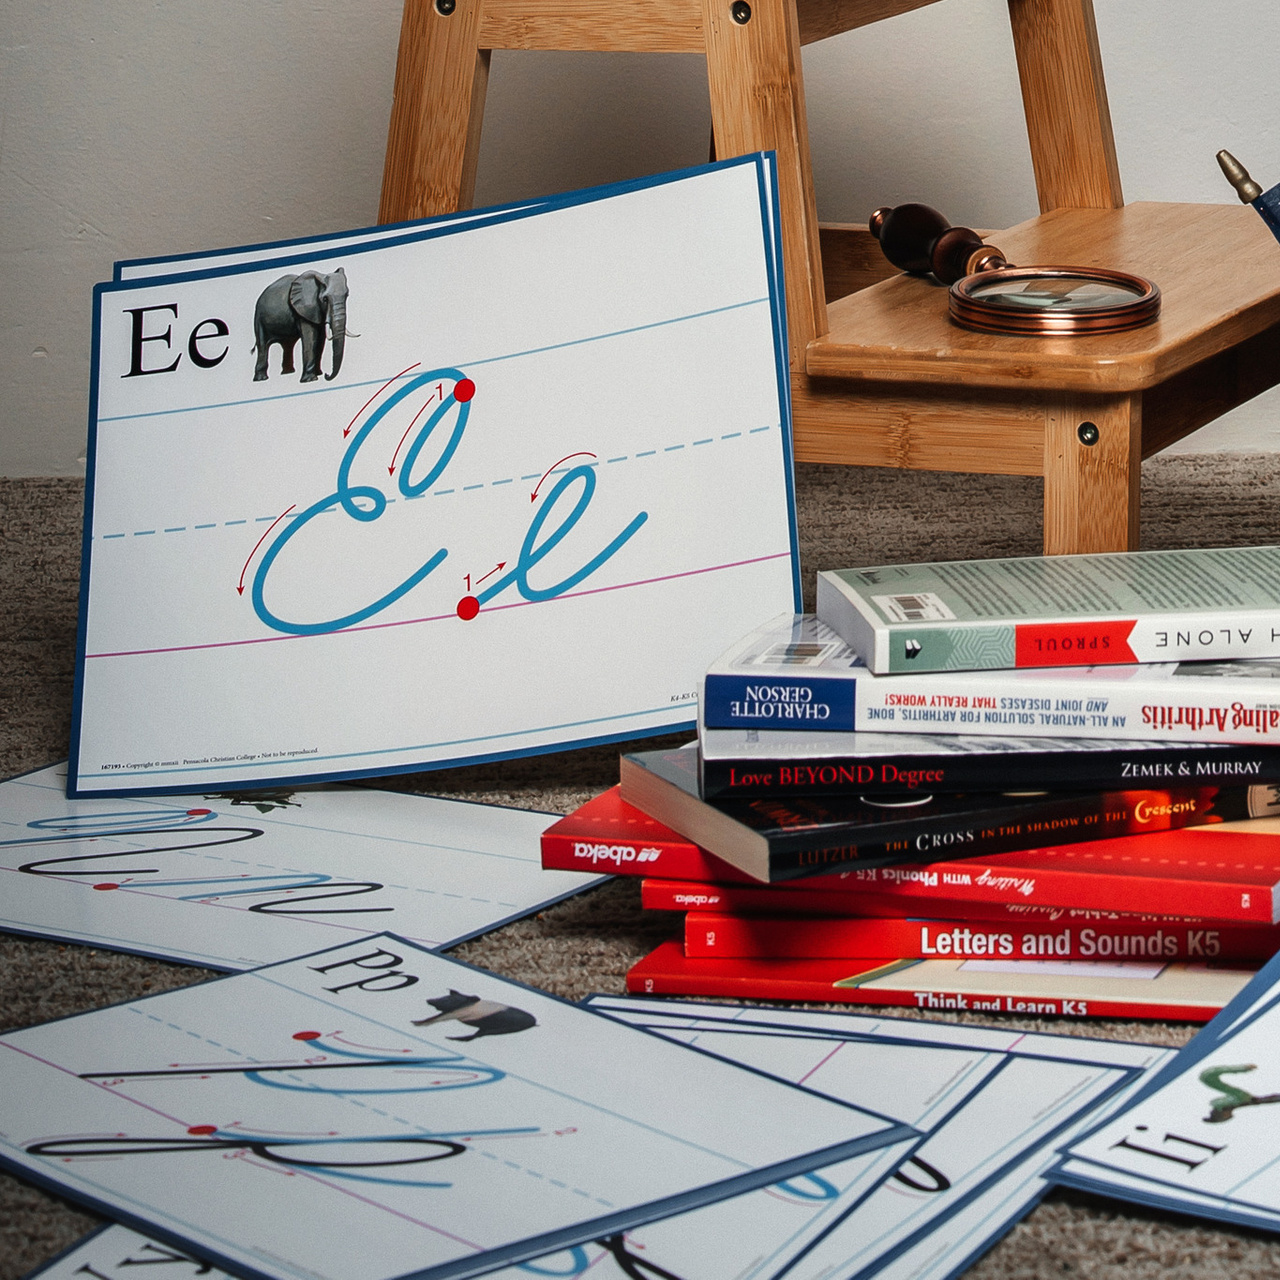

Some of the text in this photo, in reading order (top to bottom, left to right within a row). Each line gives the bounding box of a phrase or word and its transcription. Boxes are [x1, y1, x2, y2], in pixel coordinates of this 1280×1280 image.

[120, 301, 230, 379] Ee
[1034, 636, 1111, 652] SPROUL
[1155, 628, 1253, 648] ALONE
[745, 686, 813, 703] GERSON
[885, 693, 1109, 712] AND JOINT DISEASES THAT REALLY WORKS!
[730, 701, 831, 720] CHARLOTTE
[867, 707, 1126, 728] AN ALL-NATURAL SOLUTION FOR ARTHRITIS, BONE
[1141, 705, 1229, 732] Arthritis
[729, 764, 945, 789] Love BEYOND Degree
[1178, 761, 1191, 776] &
[886, 841, 910, 852] THE
[981, 828, 996, 839] IN
[999, 823, 1021, 836] THE
[1026, 817, 1081, 833] SHADOW
[1084, 814, 1100, 825] OF
[1105, 811, 1128, 822] THE
[1134, 799, 1197, 824] Crescent
[573, 843, 637, 866] abeka
[798, 845, 860, 867] LUTZER
[881, 869, 939, 887] Phonics
[975, 869, 1036, 896] Writing
[706, 931, 716, 946] K5
[920, 926, 1221, 957] Letters and Sounds K5
[306, 947, 419, 995] Pp
[913, 991, 1088, 1016] Think and Learn K5
